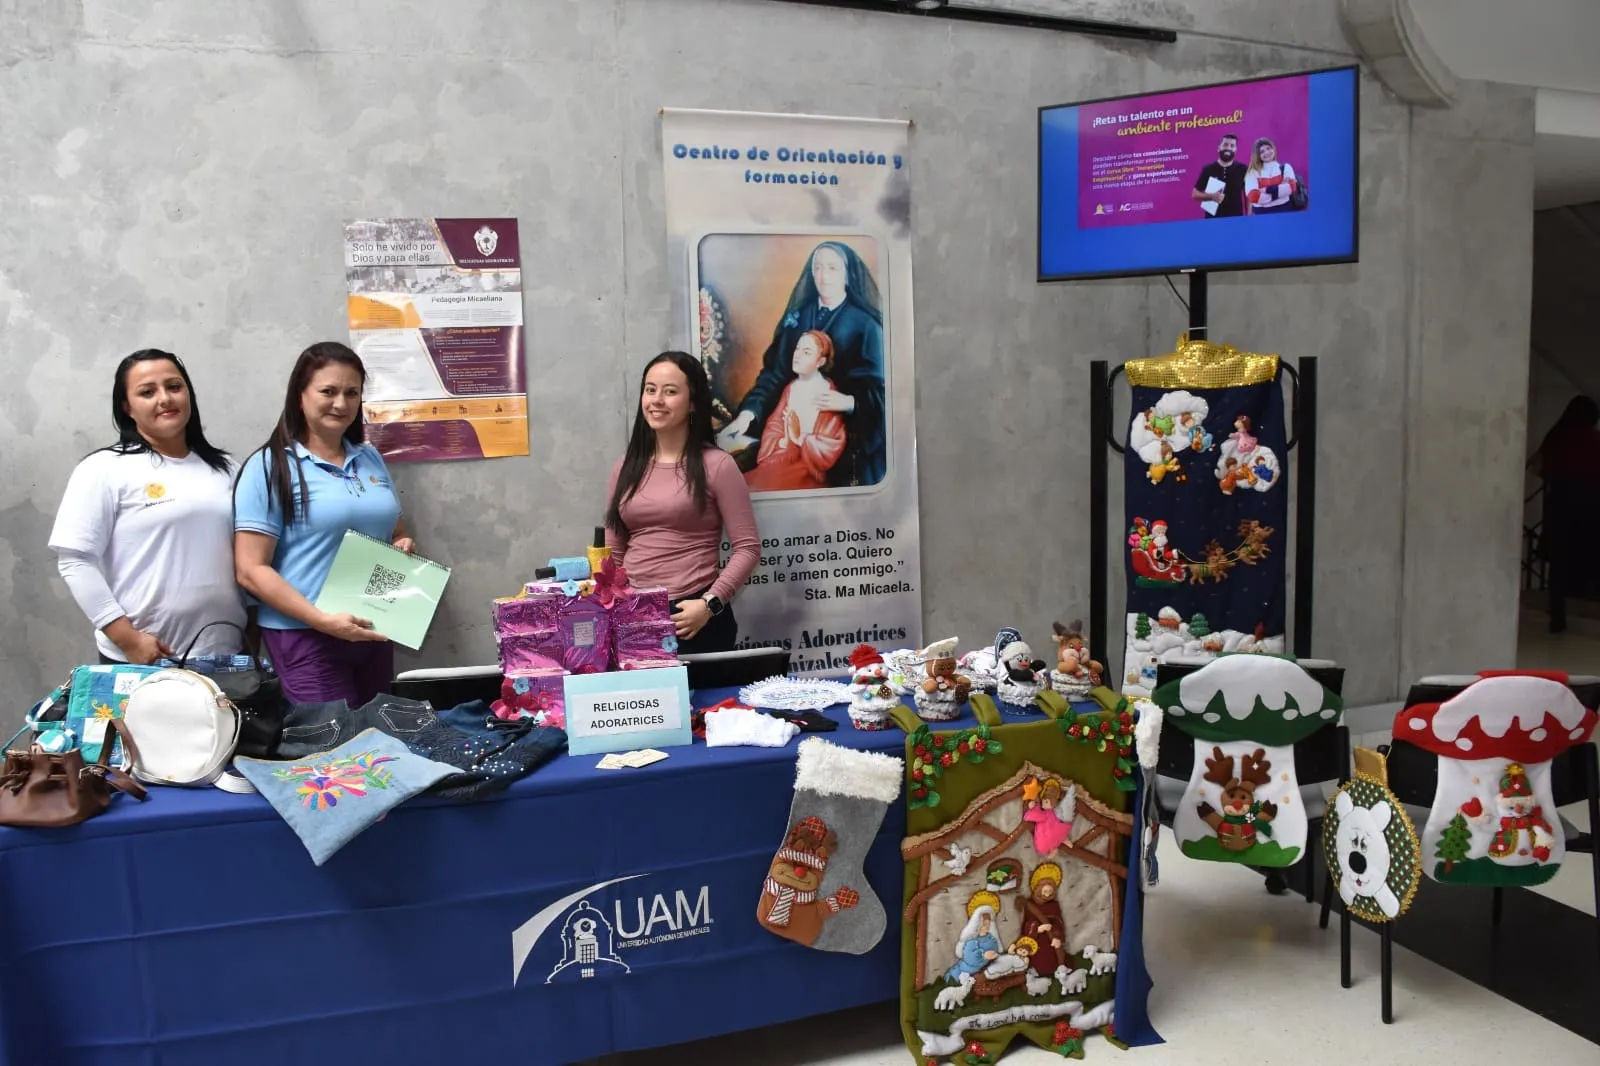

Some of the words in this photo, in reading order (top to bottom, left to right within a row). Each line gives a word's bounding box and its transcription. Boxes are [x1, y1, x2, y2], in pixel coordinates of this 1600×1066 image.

[1093, 114, 1116, 128] ¡Reta
[1118, 114, 1128, 122] tu
[1130, 110, 1164, 122] talento
[1180, 106, 1192, 114] un
[1117, 120, 1171, 136] ambiente
[1175, 110, 1243, 134] profesional!
[673, 143, 740, 160] Centro
[747, 146, 770, 161] de
[776, 147, 886, 166] Orientación
[893, 155, 903, 169] y
[352, 242, 373, 252] Solo
[376, 242, 388, 251] he
[390, 242, 418, 251] vivido
[420, 244, 436, 253] por
[352, 254, 374, 263] Dios
[376, 256, 382, 264] y
[384, 256, 406, 264] para
[408, 254, 430, 262] ellas
[784, 534, 820, 547] amar
[824, 534, 832, 544] a
[836, 530, 871, 543] Dios.
[876, 528, 894, 540] No
[760, 554, 783, 566] ser
[787, 553, 804, 568] yo
[809, 549, 841, 563] sola.
[846, 546, 892, 560] Quiero
[774, 571, 786, 583] le
[791, 568, 829, 582] amen
[804, 587, 831, 600] Sta.
[836, 586, 854, 598] Ma
[860, 581, 914, 596] Micaela.
[798, 624, 906, 649] Adoratrices
[789, 652, 850, 673] nizales
[593, 698, 660, 713] RELIGIOSAS
[590, 715, 664, 729] ADORATRICES
[615, 885, 710, 939] UAM
